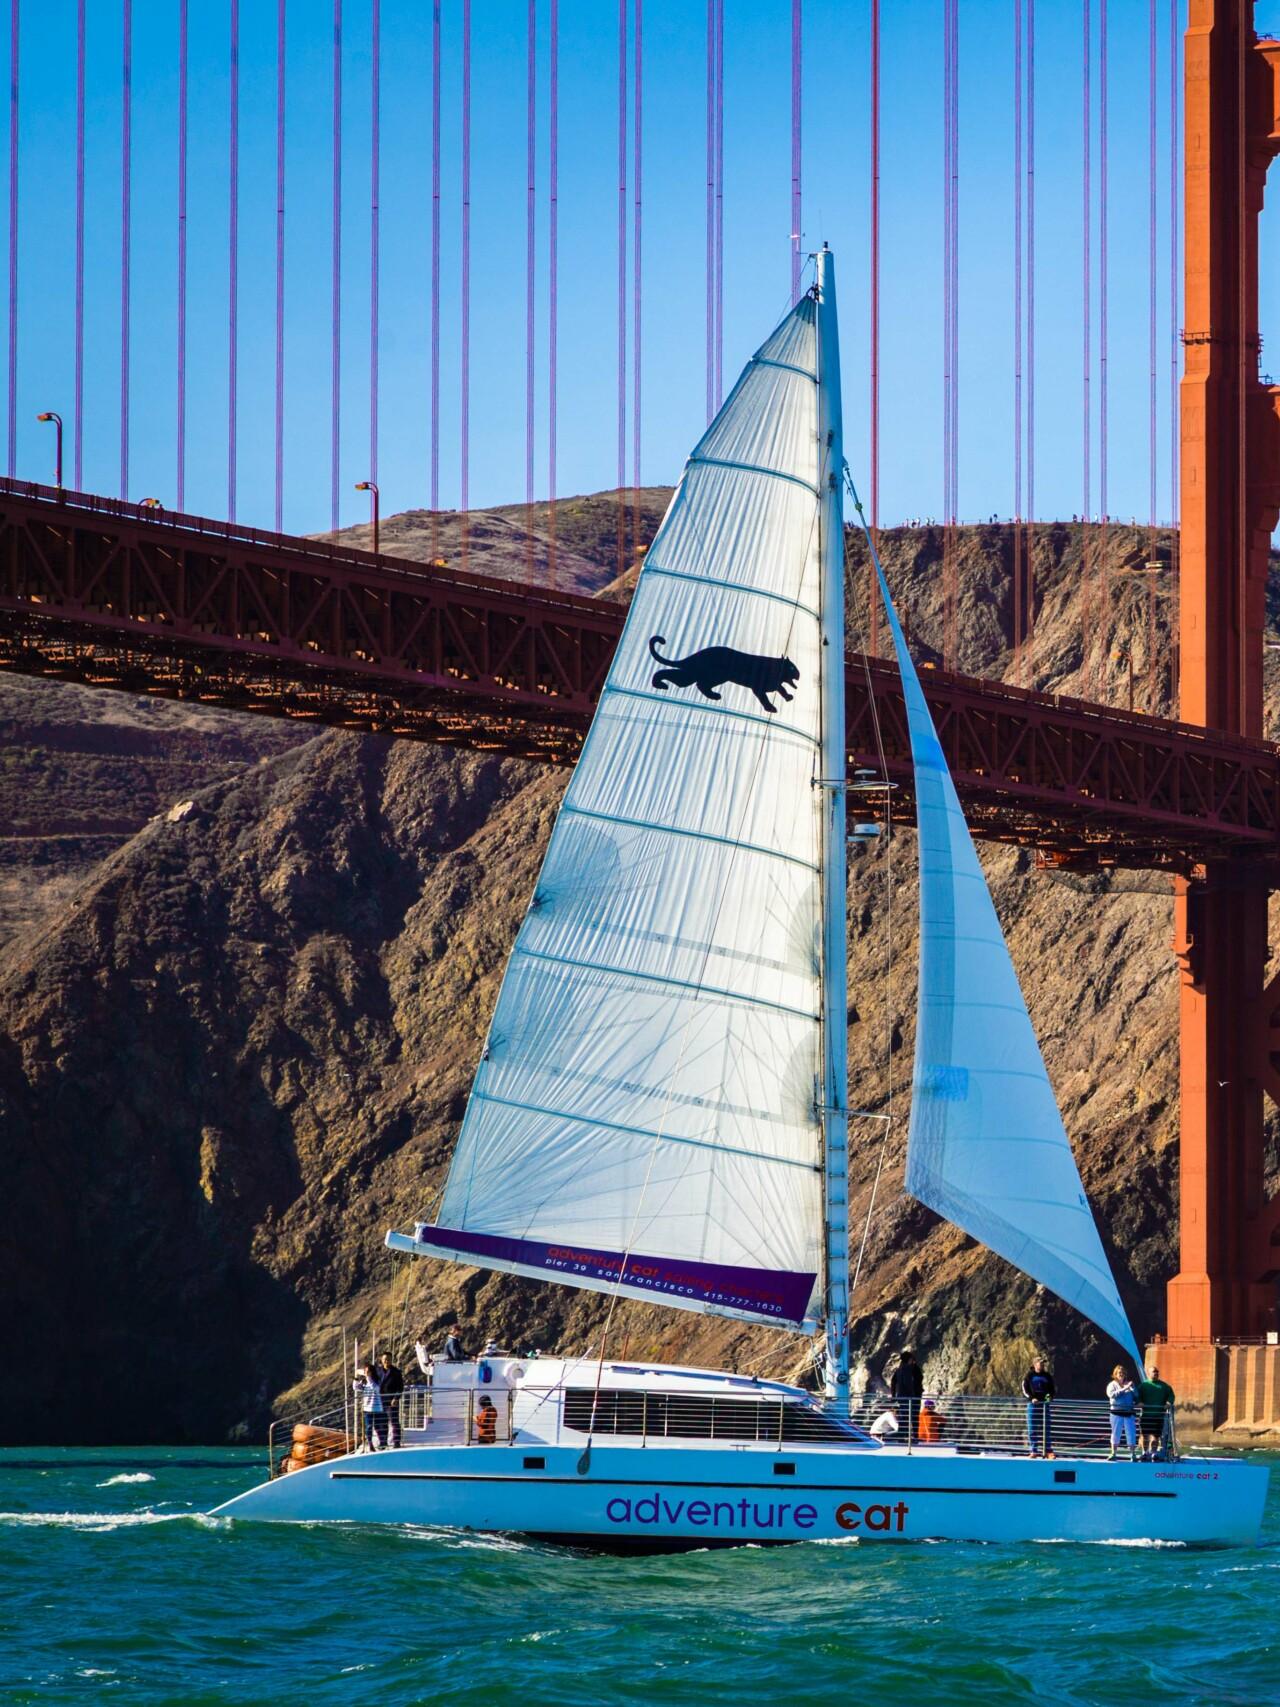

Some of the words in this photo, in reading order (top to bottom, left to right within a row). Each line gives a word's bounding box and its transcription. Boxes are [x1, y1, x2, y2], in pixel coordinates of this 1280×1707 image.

[545, 1258, 568, 1268] pier
[573, 1263, 587, 1271] 39
[703, 1292, 782, 1313] 415-777-1630
[631, 1263, 660, 1277] cat
[606, 1492, 818, 1529] adventure
[835, 1501, 909, 1532] cat
